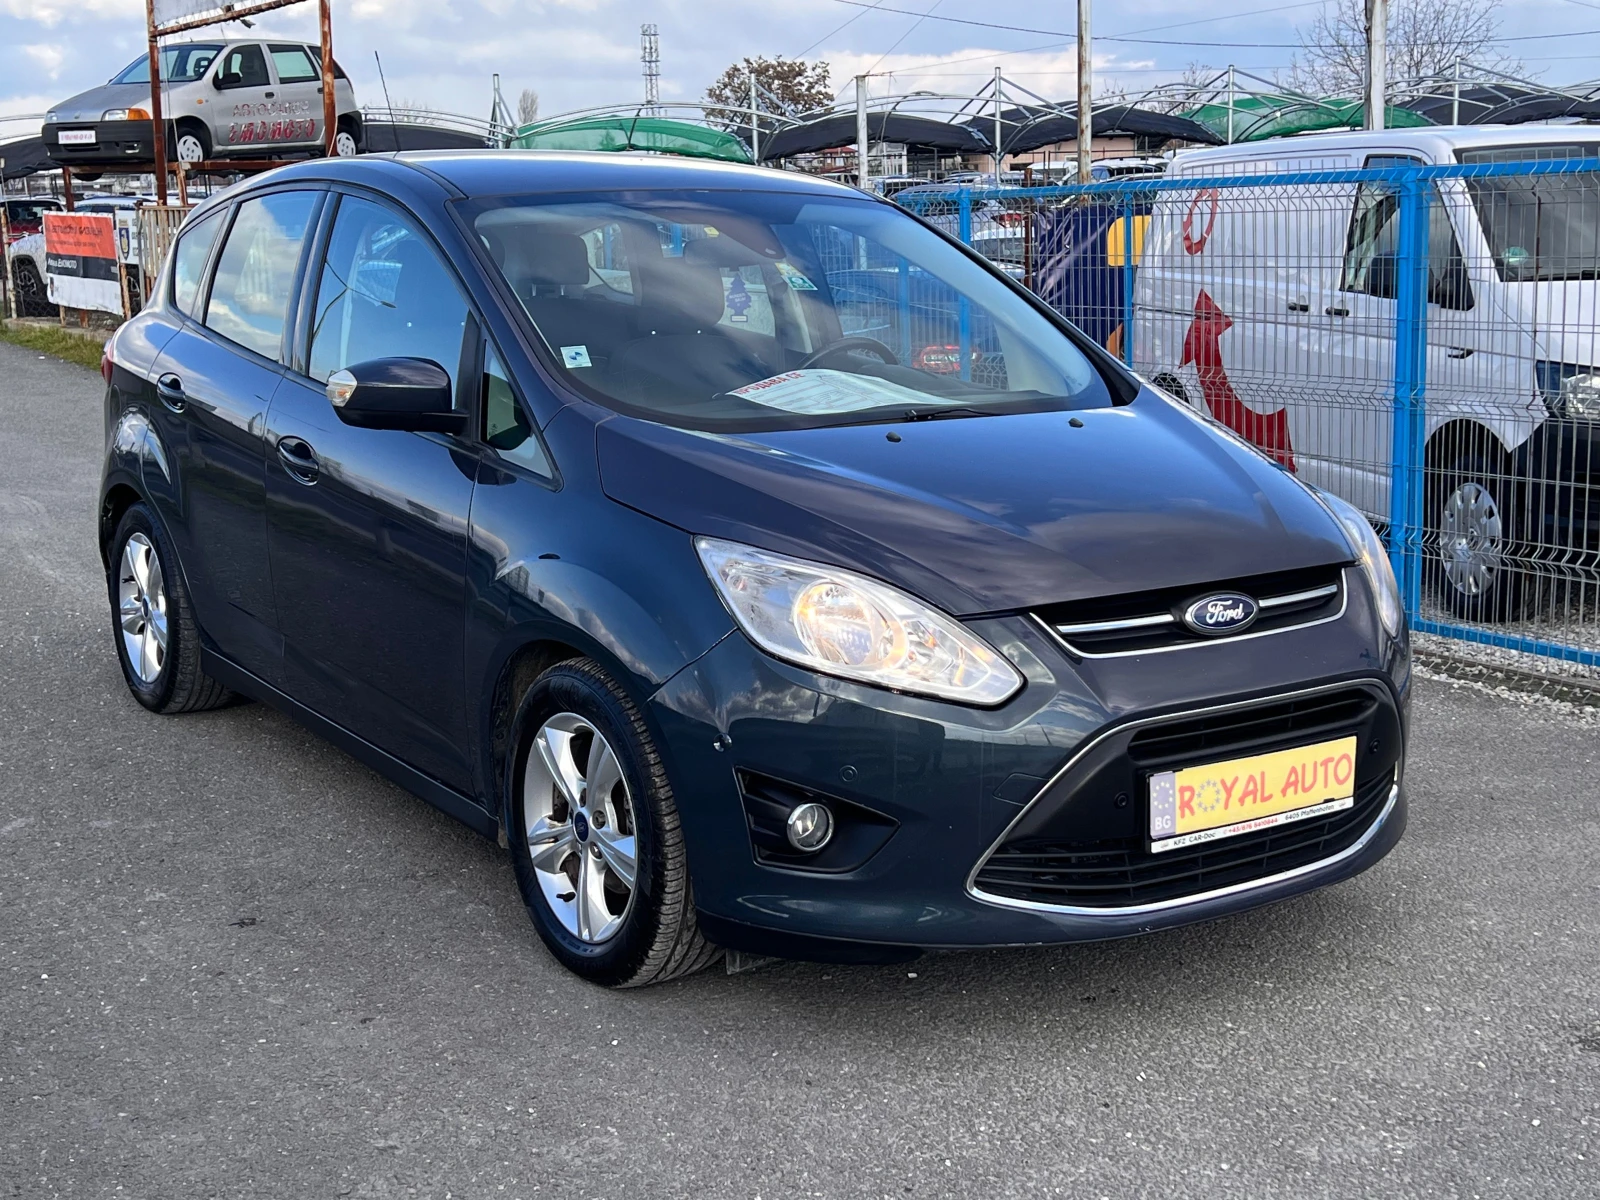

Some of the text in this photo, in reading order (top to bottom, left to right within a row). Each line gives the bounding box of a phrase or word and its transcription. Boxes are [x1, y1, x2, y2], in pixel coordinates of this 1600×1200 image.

[1205, 599, 1245, 624] Ford
[1178, 753, 1353, 819] ROYAL AUTO
[1154, 815, 1172, 831] BG
